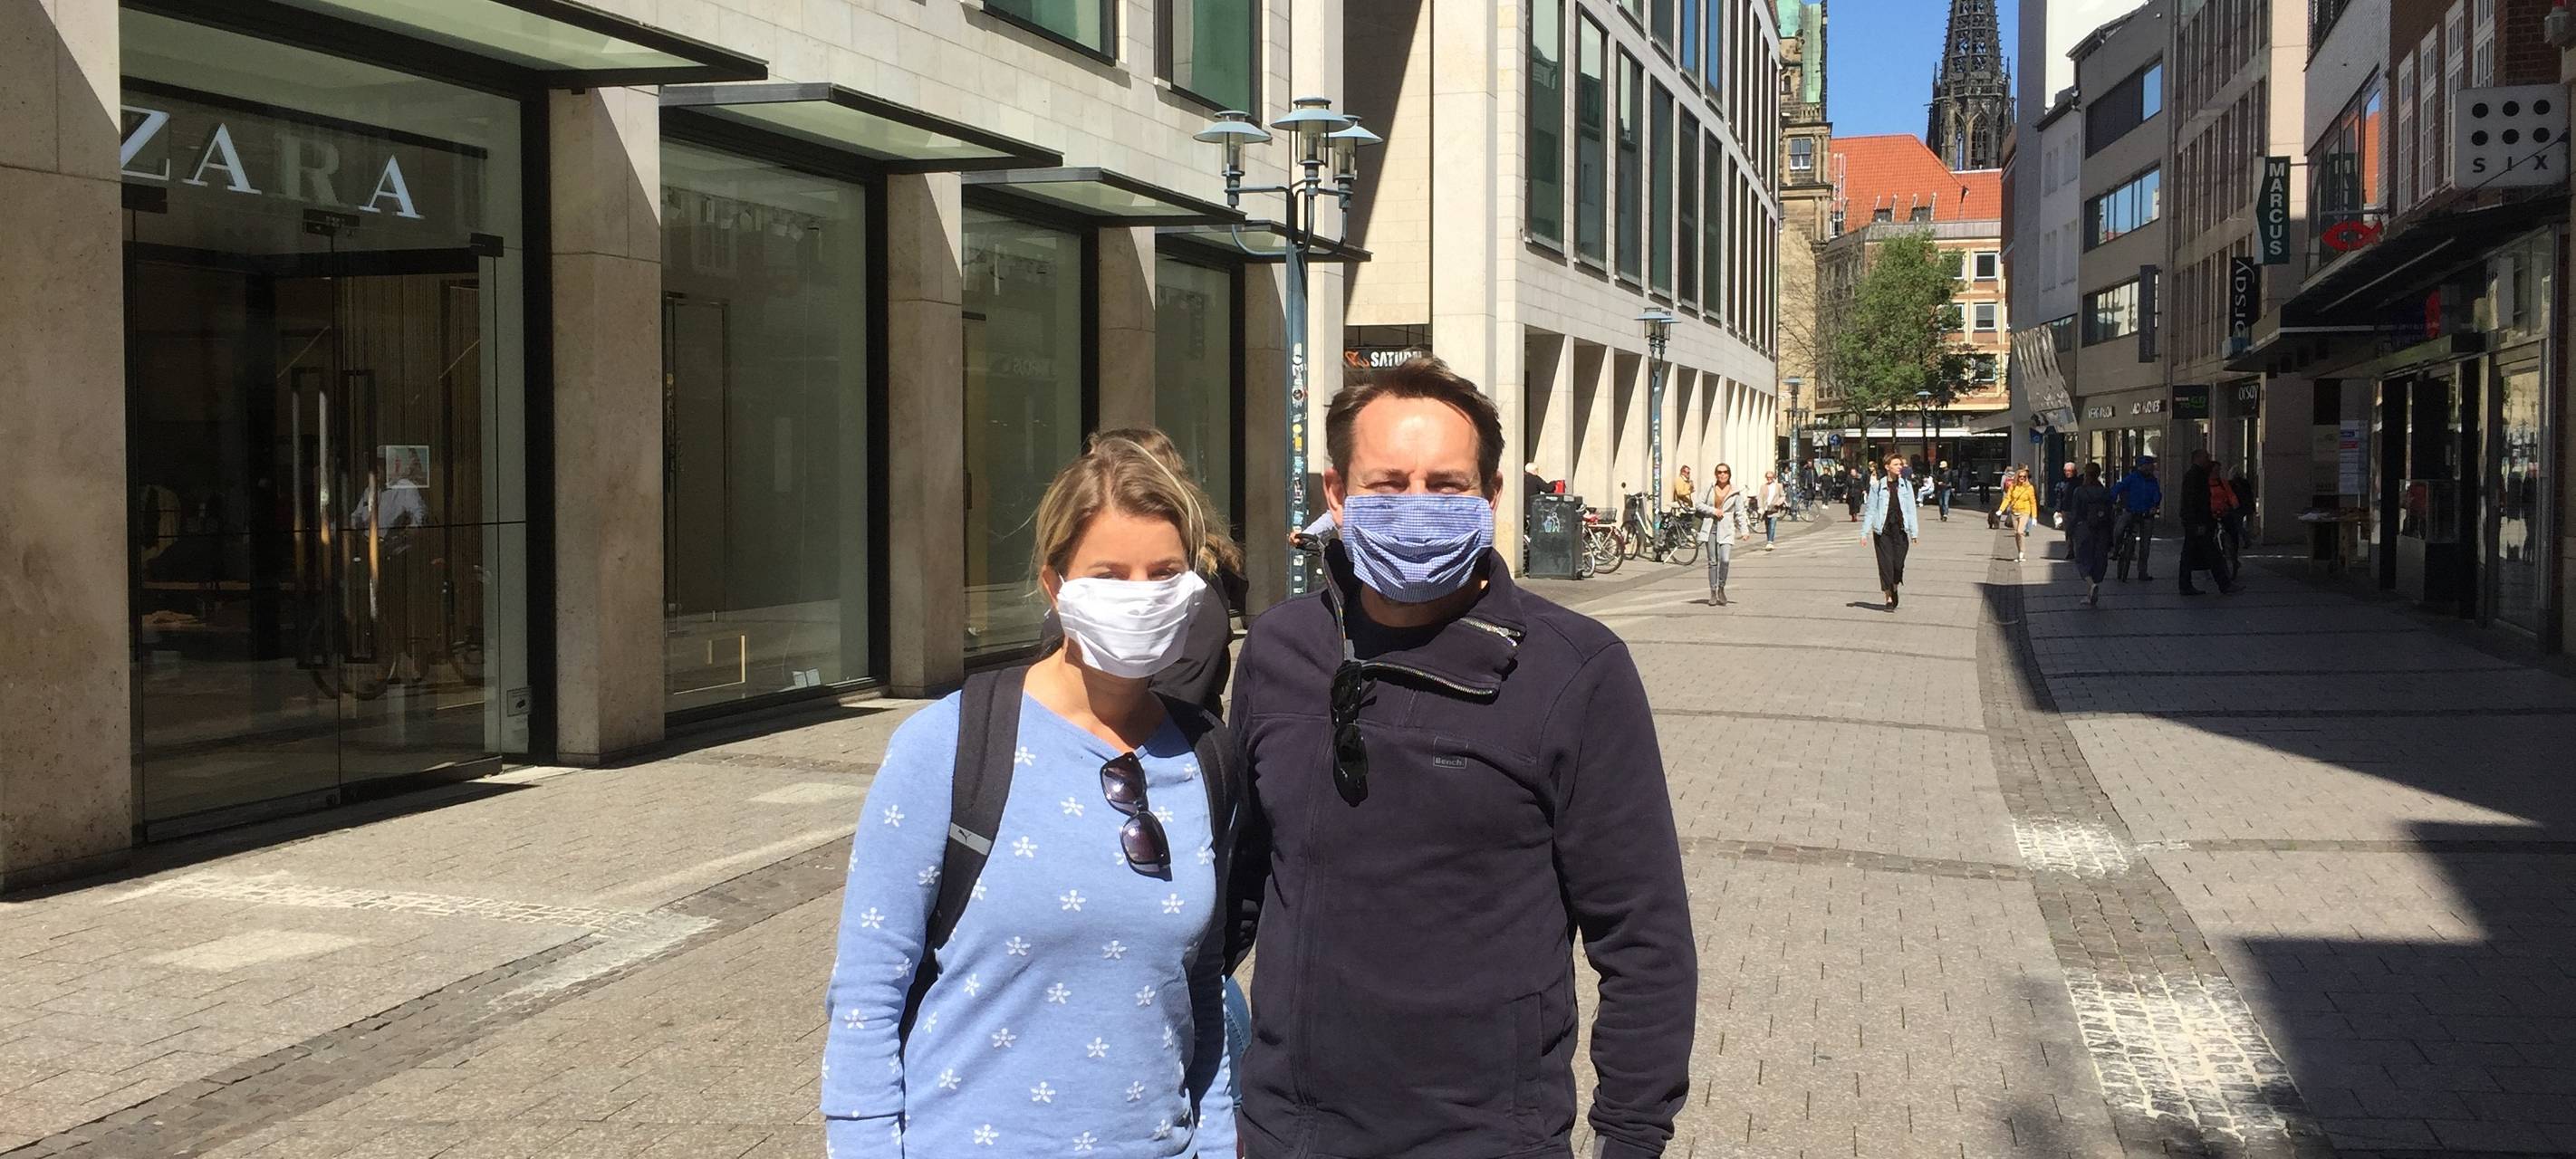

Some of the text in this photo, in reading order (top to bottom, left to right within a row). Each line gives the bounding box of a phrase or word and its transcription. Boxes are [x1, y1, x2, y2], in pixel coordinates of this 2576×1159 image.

[120, 104, 425, 219] ZARA
[2472, 154, 2549, 174] SIX
[2269, 162, 2285, 256] MARCUS
[2235, 259, 2254, 332] orsay
[2238, 384, 2259, 410] orsay
